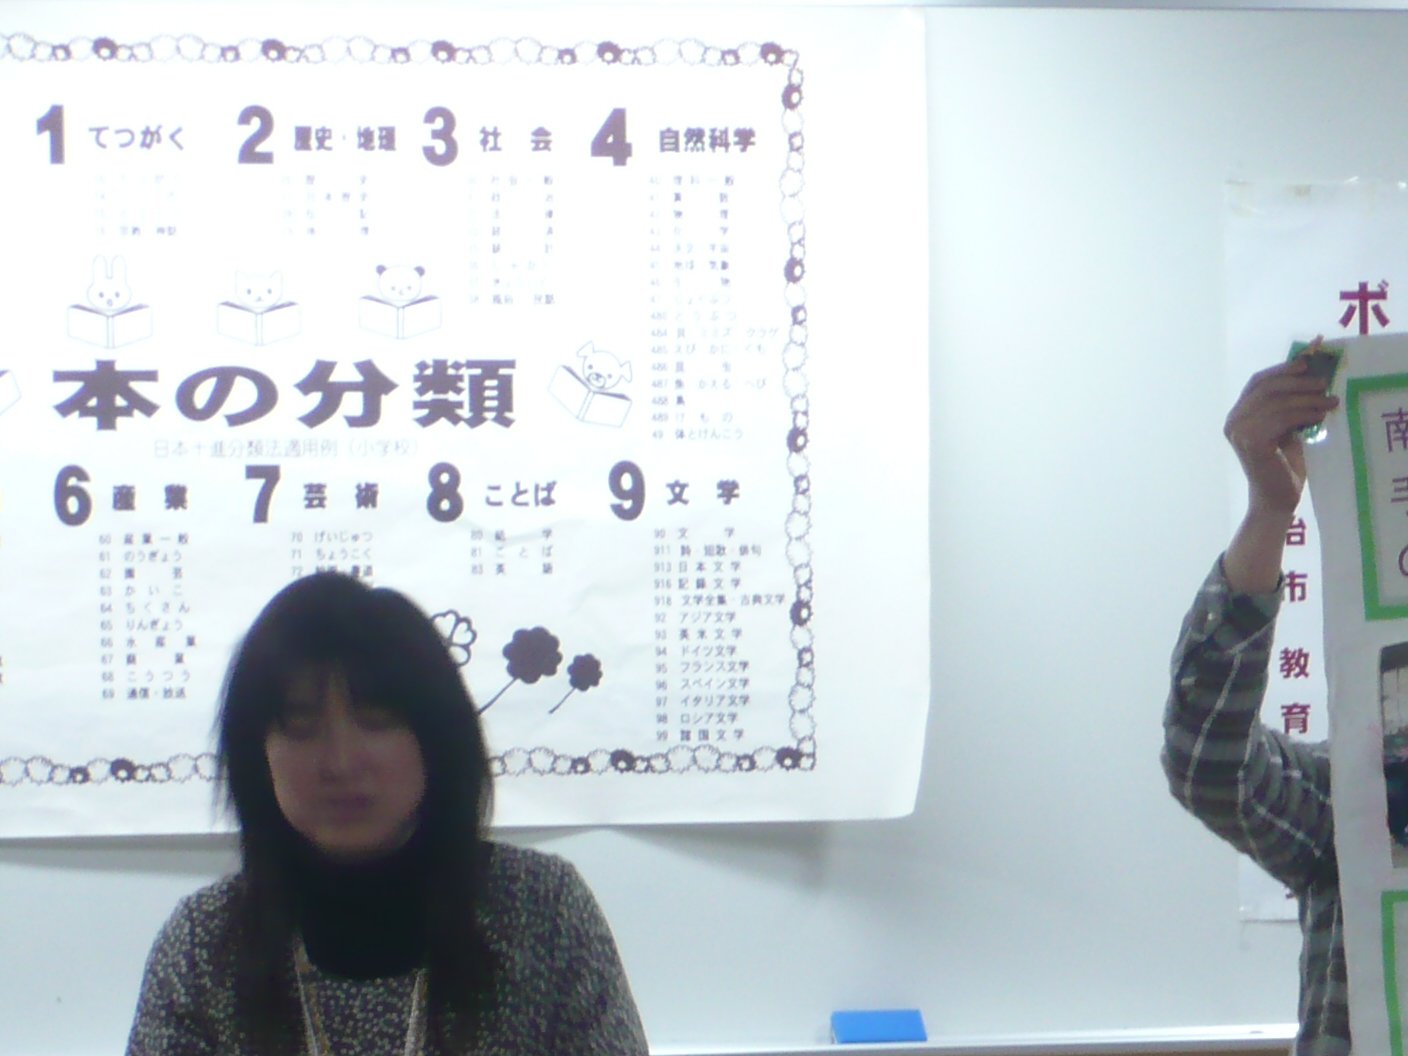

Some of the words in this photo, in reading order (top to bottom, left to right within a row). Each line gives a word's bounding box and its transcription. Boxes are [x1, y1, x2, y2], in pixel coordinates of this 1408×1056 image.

[36, 104, 65, 165] 1
[88, 125, 185, 151] てつがく
[237, 104, 275, 165] 2
[421, 105, 460, 167] 3
[590, 107, 633, 167] 4
[659, 127, 757, 153] 自然科学
[1339, 279, 1391, 335] ボ
[52, 358, 517, 431] 本の分類
[53, 464, 93, 526] 6
[245, 464, 281, 524] 7
[426, 461, 465, 523] 8
[485, 479, 558, 508] ことば
[608, 460, 646, 521] 9
[665, 478, 741, 506] 文学
[290, 531, 304, 543] 70
[313, 530, 374, 544] げいじゅつ
[290, 548, 302, 560] 71
[315, 547, 373, 561] ちょうこく
[653, 545, 671, 556] 911
[653, 561, 672, 572] 913
[678, 560, 742, 573] 日本文学
[654, 612, 667, 623] 92
[679, 611, 737, 624] アジア文学
[679, 660, 750, 674] フランス文学
[681, 644, 738, 657] ドイツ文学
[655, 696, 668, 707] 97
[680, 694, 751, 708] イタリア文学
[680, 677, 750, 690] スペイン文学
[1279, 647, 1311, 735] 教育
[680, 712, 739, 725] ロシア文学
